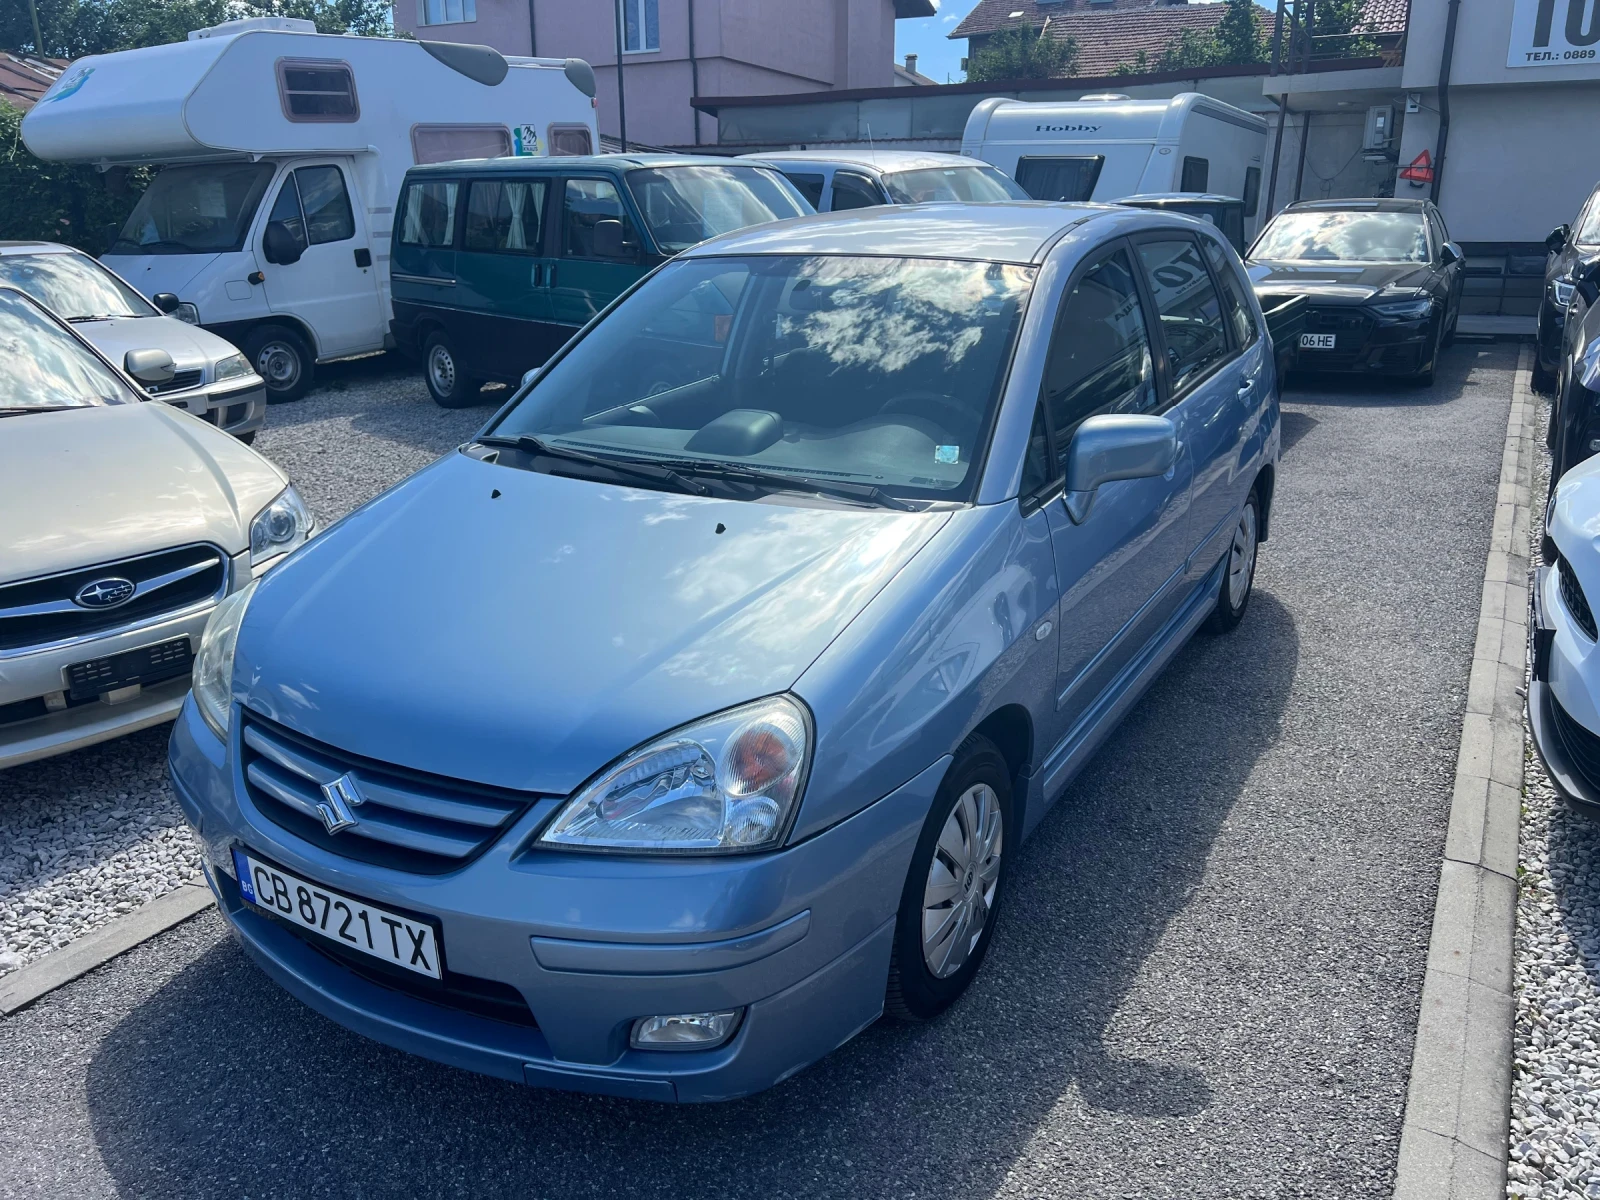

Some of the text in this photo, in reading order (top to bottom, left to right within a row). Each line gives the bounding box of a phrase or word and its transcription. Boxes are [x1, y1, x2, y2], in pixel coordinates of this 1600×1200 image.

[1525, 49, 1596, 62] ТЕЛ.: 0889
[1035, 124, 1102, 133] Hobby
[1301, 335, 1333, 347] 06 HE
[241, 879, 254, 895] BG
[253, 865, 431, 971] CB 8721 TX
